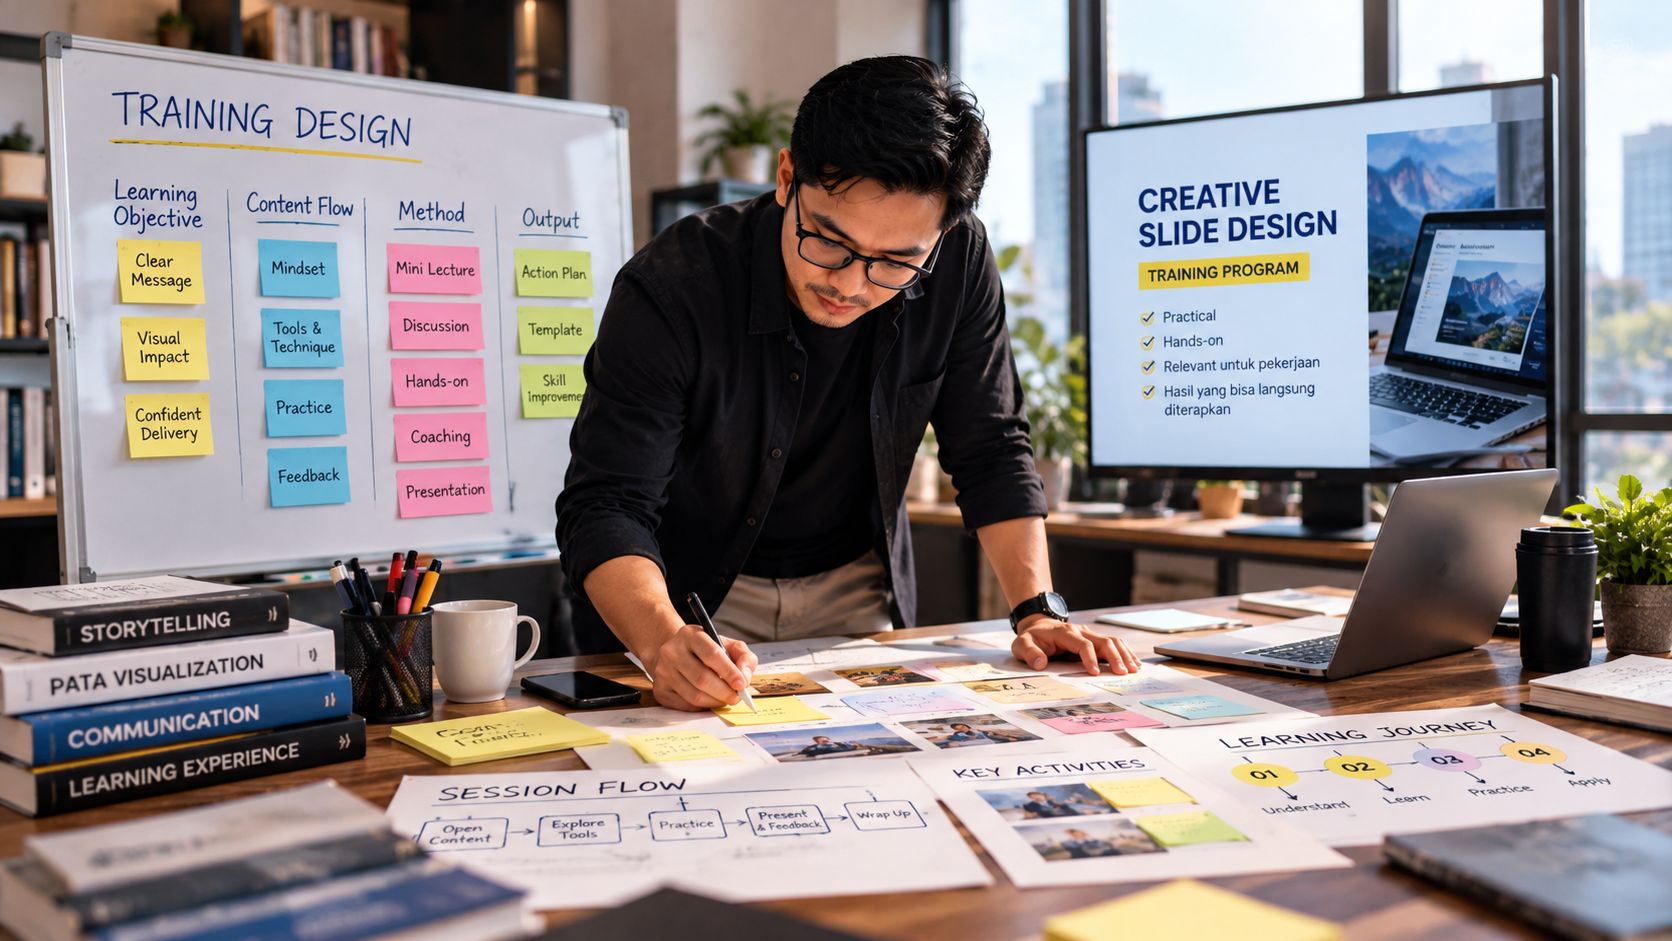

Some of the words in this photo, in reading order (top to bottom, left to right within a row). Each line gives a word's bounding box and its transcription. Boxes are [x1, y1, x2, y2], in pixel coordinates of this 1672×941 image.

[111, 91, 273, 139] TRAINING
[295, 107, 411, 148] DESIGN
[114, 178, 197, 211] Learning
[1138, 178, 1280, 214] CREATIVE
[246, 191, 313, 214] Content
[318, 196, 354, 217] Flow
[398, 200, 465, 223] Method
[113, 205, 203, 234] Objective
[522, 207, 580, 234] Output
[1138, 218, 1219, 248] SLIDE
[1228, 210, 1337, 242] DESIGN
[135, 253, 174, 269] Clear
[271, 260, 326, 276] Mindset
[396, 261, 423, 275] Mini
[428, 262, 476, 277] Lecture
[522, 264, 559, 280] Action
[562, 266, 587, 280] Plan
[1148, 266, 1219, 283] TRAINING
[1222, 260, 1299, 278] PROGRAM
[131, 273, 192, 292] Message
[1162, 308, 1217, 324] Practical
[273, 321, 308, 336] Tools
[312, 322, 322, 335] &
[403, 318, 470, 333] Discussion
[528, 322, 583, 340] Template
[137, 331, 181, 346] Visual
[1163, 334, 1224, 349] Hands-on
[271, 340, 336, 358] Technique
[139, 349, 190, 368] Impact
[1164, 359, 1217, 373] Relevant
[1220, 358, 1255, 372] untuk
[1258, 356, 1321, 373] pekerjaan
[406, 373, 469, 388] Hands-on
[542, 374, 567, 387] Skill
[1164, 384, 1194, 398] Hasil
[1196, 386, 1227, 400] yang
[1230, 383, 1255, 396] bisa
[1258, 382, 1316, 398] langsung
[135, 406, 202, 423] Confident
[276, 400, 333, 416] Practice
[1164, 403, 1232, 419] diterapkan
[141, 426, 199, 444] Delivery
[410, 428, 472, 448] Coaching
[278, 468, 341, 485] Feedback
[406, 483, 486, 499] Presentation
[80, 611, 231, 643] STORYTELLING
[50, 672, 108, 696] PATA
[113, 654, 264, 687] VISUALIZATION
[68, 703, 260, 749] COMMUNICATION
[1219, 730, 1368, 750] LEARNING
[1376, 719, 1497, 739] JOURNEY
[1431, 754, 1464, 765] 03
[1518, 748, 1551, 759] 04
[69, 764, 178, 799] LEARNING
[183, 742, 300, 777] EXPERIENCE
[952, 767, 1000, 780] KEY
[1016, 759, 1147, 776] ACTIVITIES
[1250, 770, 1279, 780] 01
[1341, 762, 1376, 773] 02
[438, 782, 577, 802] SESSION
[598, 778, 687, 795] FLOW
[1467, 784, 1534, 797] Practice
[1261, 800, 1351, 815] Understand
[1382, 796, 1432, 805] Learn
[758, 810, 808, 821] Present
[856, 812, 891, 820] Wrap
[892, 810, 912, 819] Up
[442, 824, 483, 836] Open
[551, 818, 606, 830] Explore
[659, 820, 716, 830] Practice
[429, 834, 492, 845] Content
[558, 830, 599, 840] Tools
